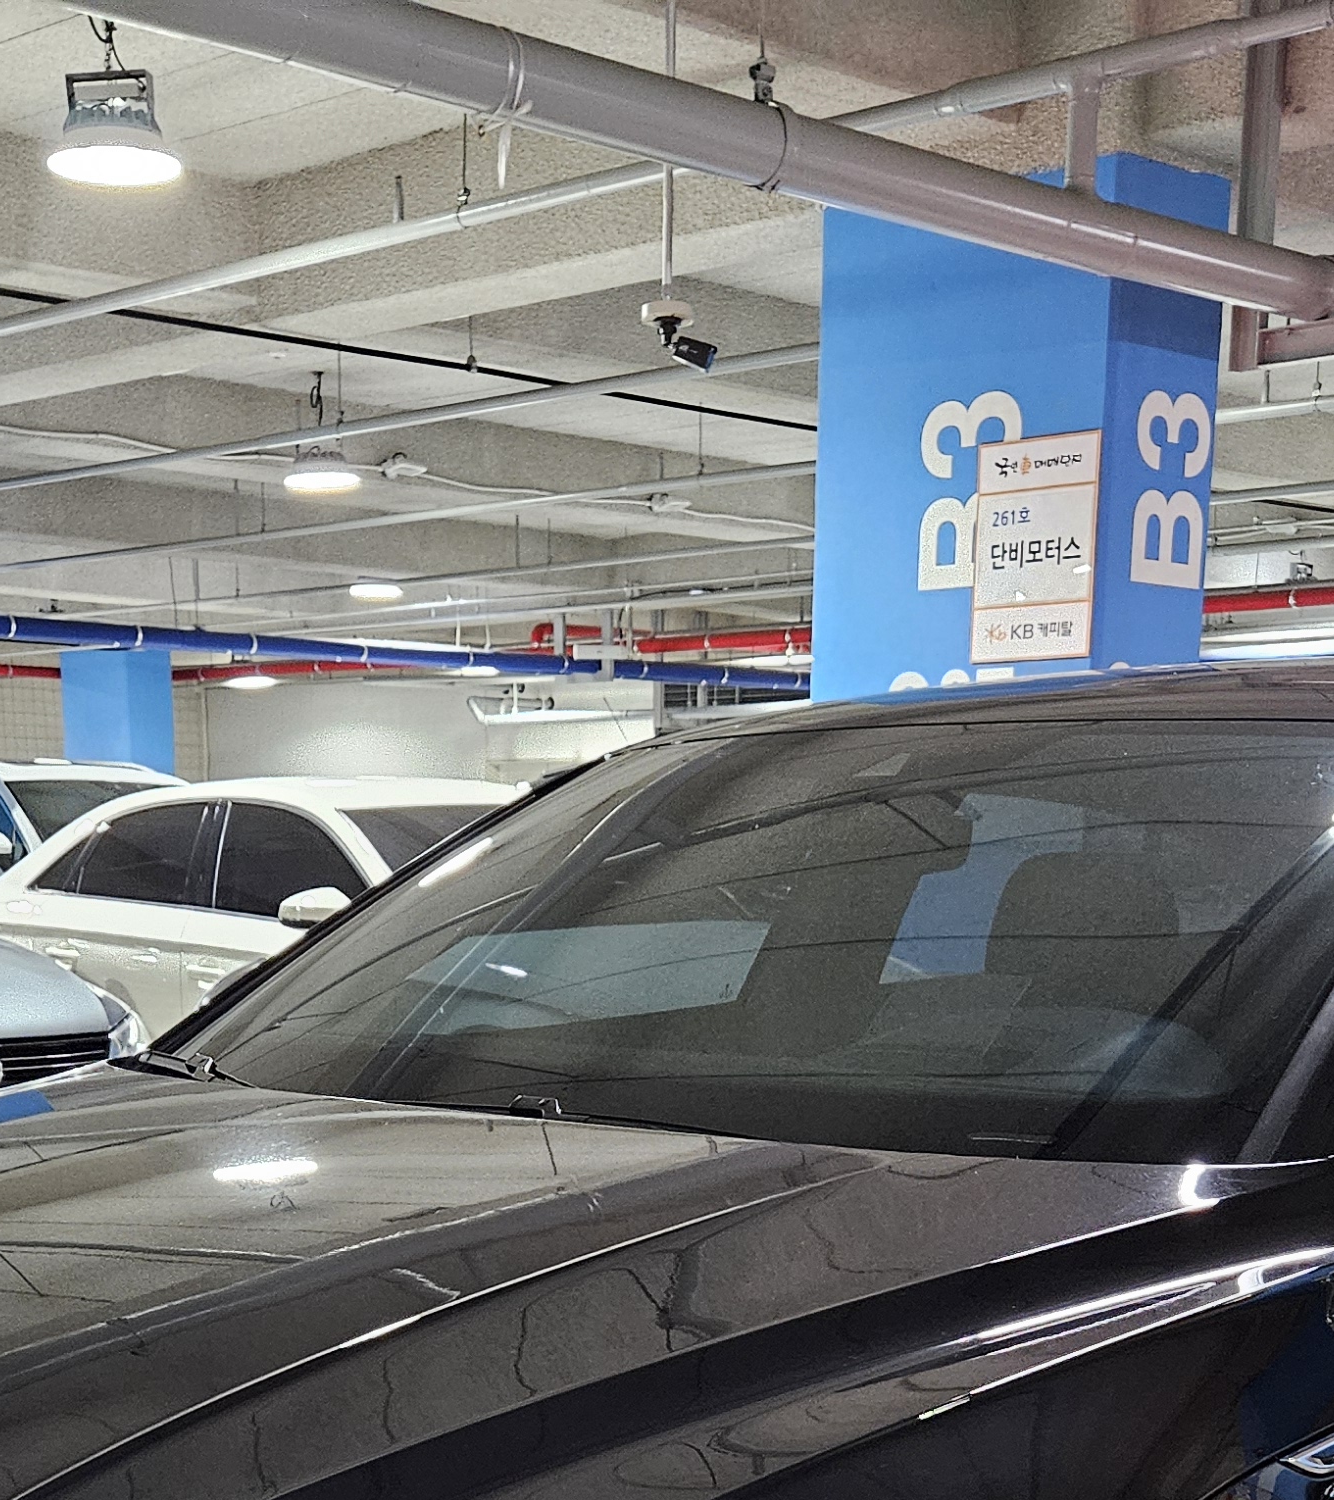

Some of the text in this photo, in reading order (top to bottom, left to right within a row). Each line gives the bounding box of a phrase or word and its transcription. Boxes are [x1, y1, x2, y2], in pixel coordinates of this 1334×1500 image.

[1130, 390, 1211, 589] B3
[992, 507, 1031, 527] 261호
[990, 537, 1081, 570] 단비모터스
[1010, 624, 1034, 640] KB
